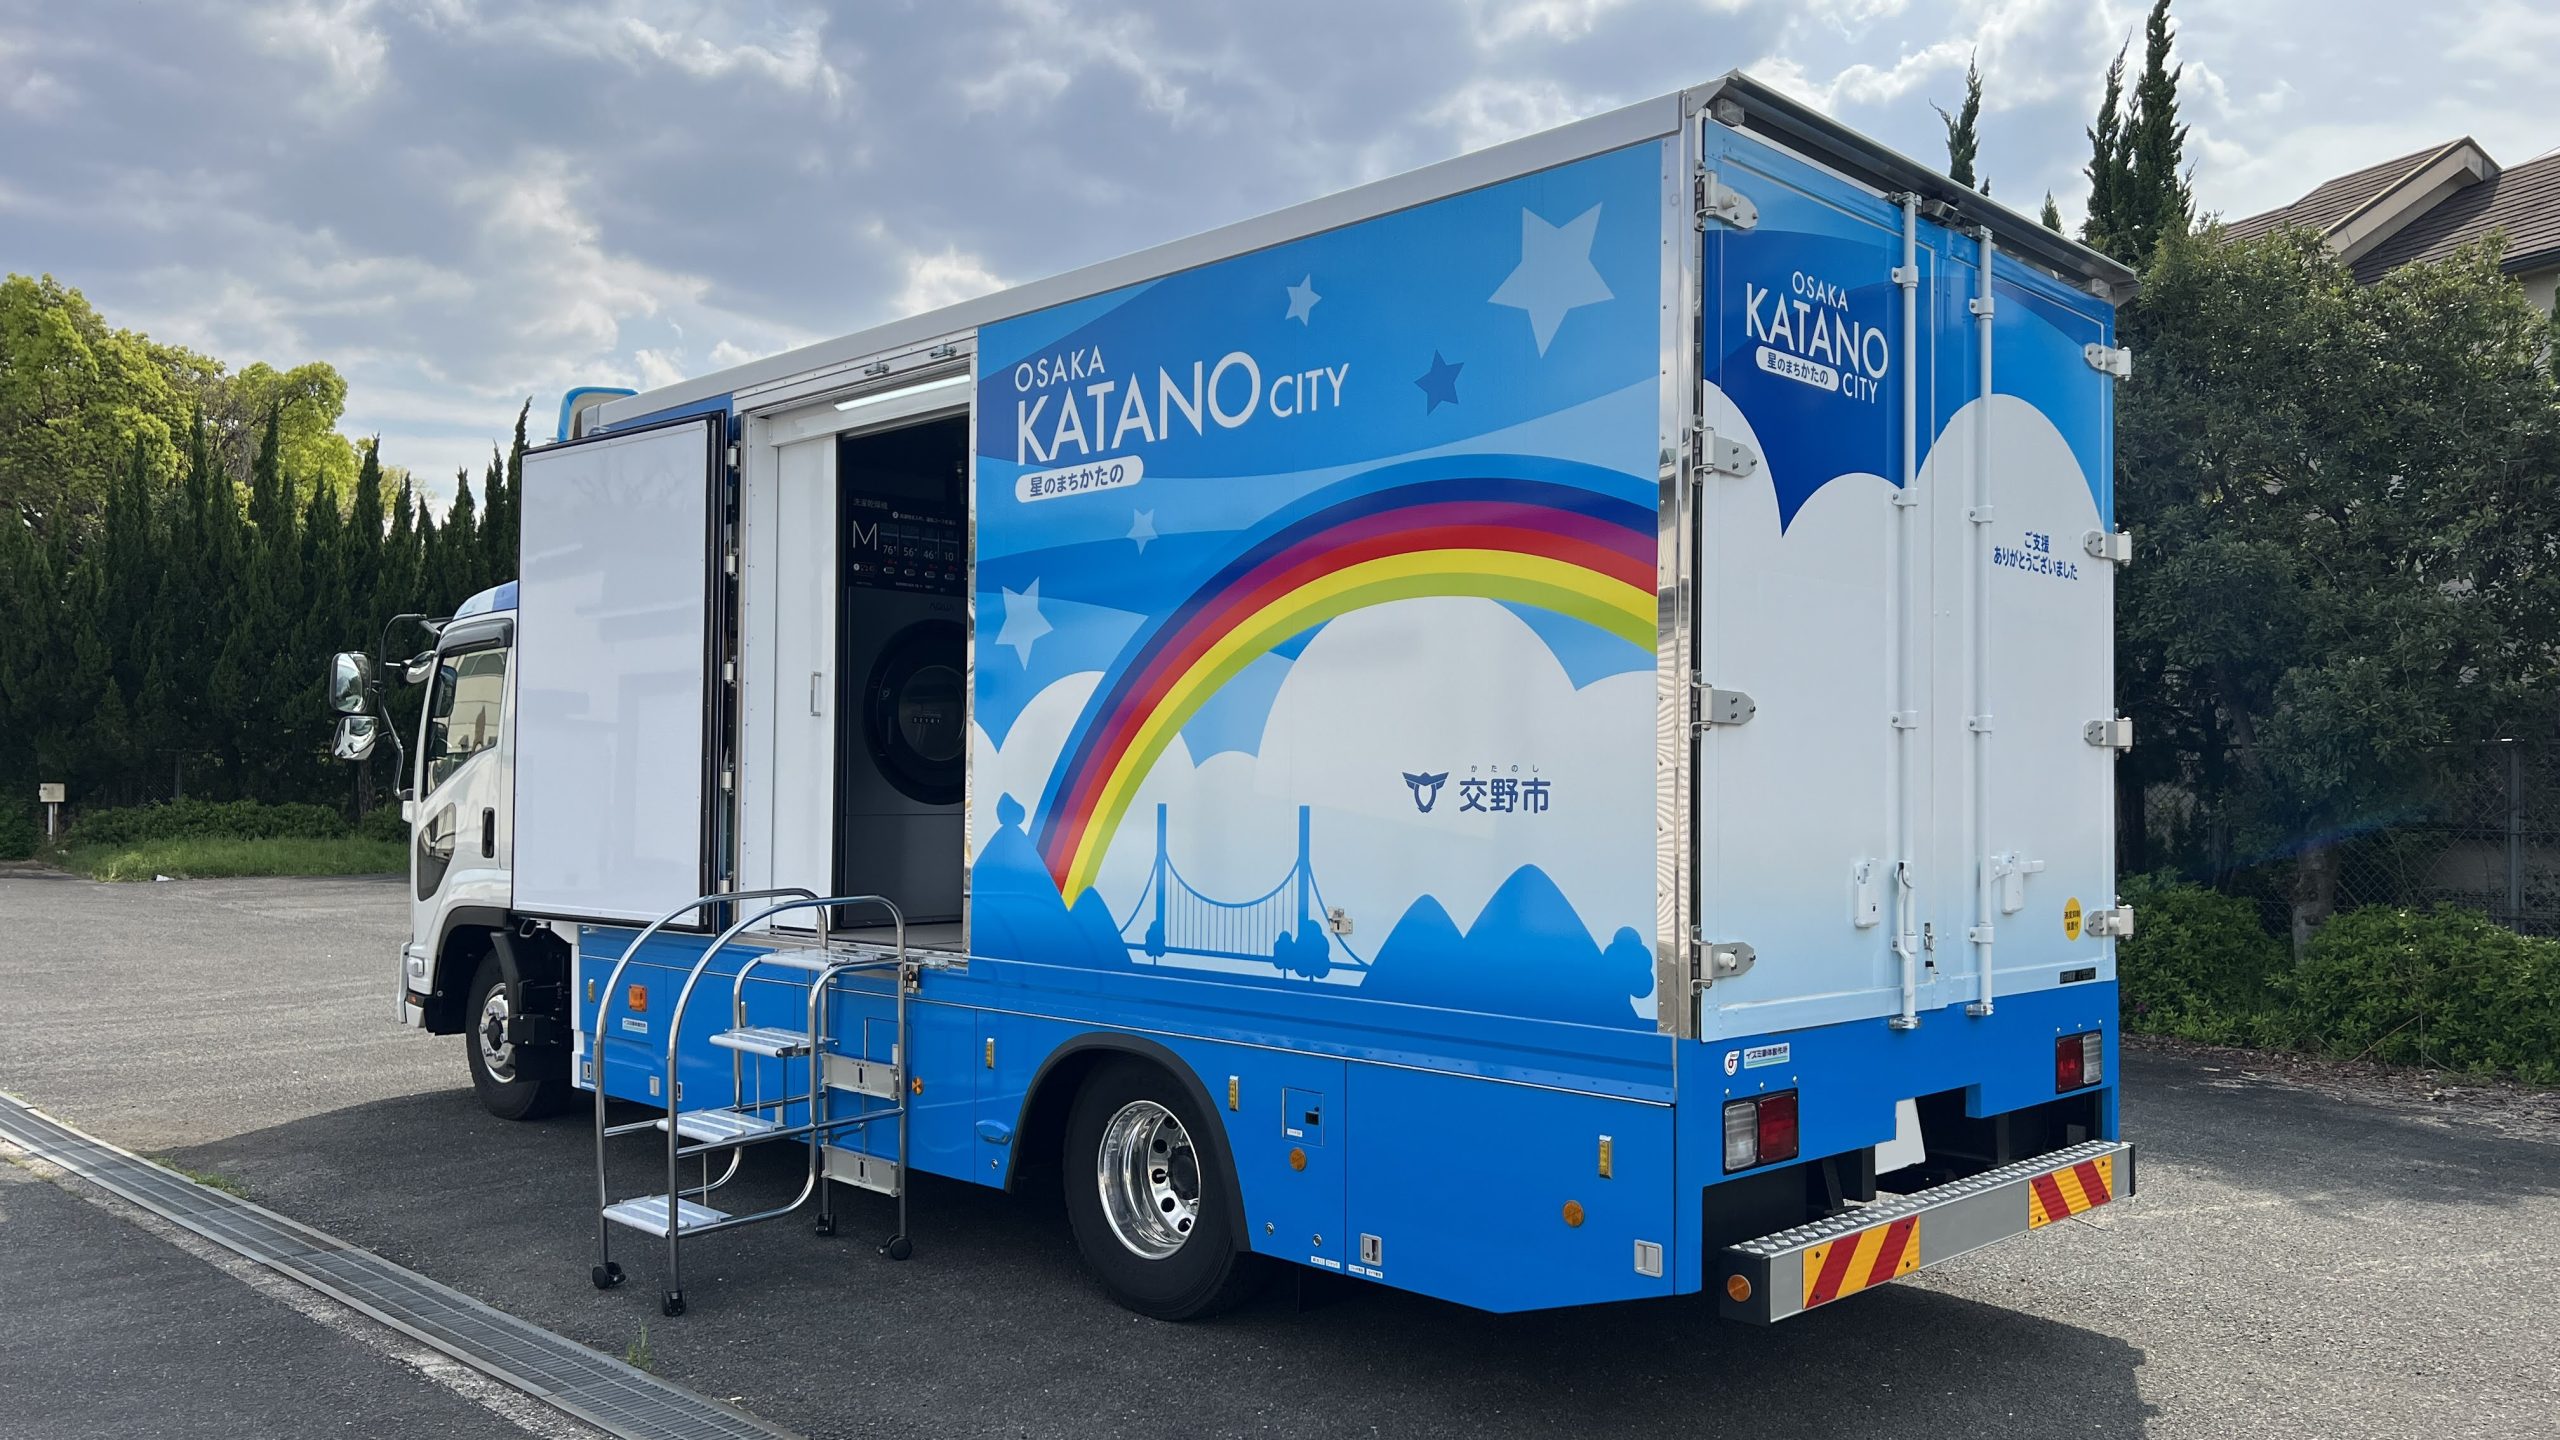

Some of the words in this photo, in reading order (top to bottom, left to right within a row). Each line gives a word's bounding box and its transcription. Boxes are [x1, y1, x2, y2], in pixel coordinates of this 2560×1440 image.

[1792, 271, 1848, 312] OSAKA
[1746, 283, 1888, 379] KATANO
[1014, 345, 1105, 392] OSAKA
[1767, 352, 1829, 385] 星のまちかたの
[1842, 373, 1878, 404] CITY
[1018, 351, 1261, 466] KATANO
[1269, 363, 1350, 418] CITY
[1029, 464, 1124, 498] 星のまちかたの
[852, 520, 877, 551] M
[2025, 531, 2050, 553] ご支援
[1994, 546, 2078, 579] ありがとうございました
[1460, 777, 1550, 813] 交野市
